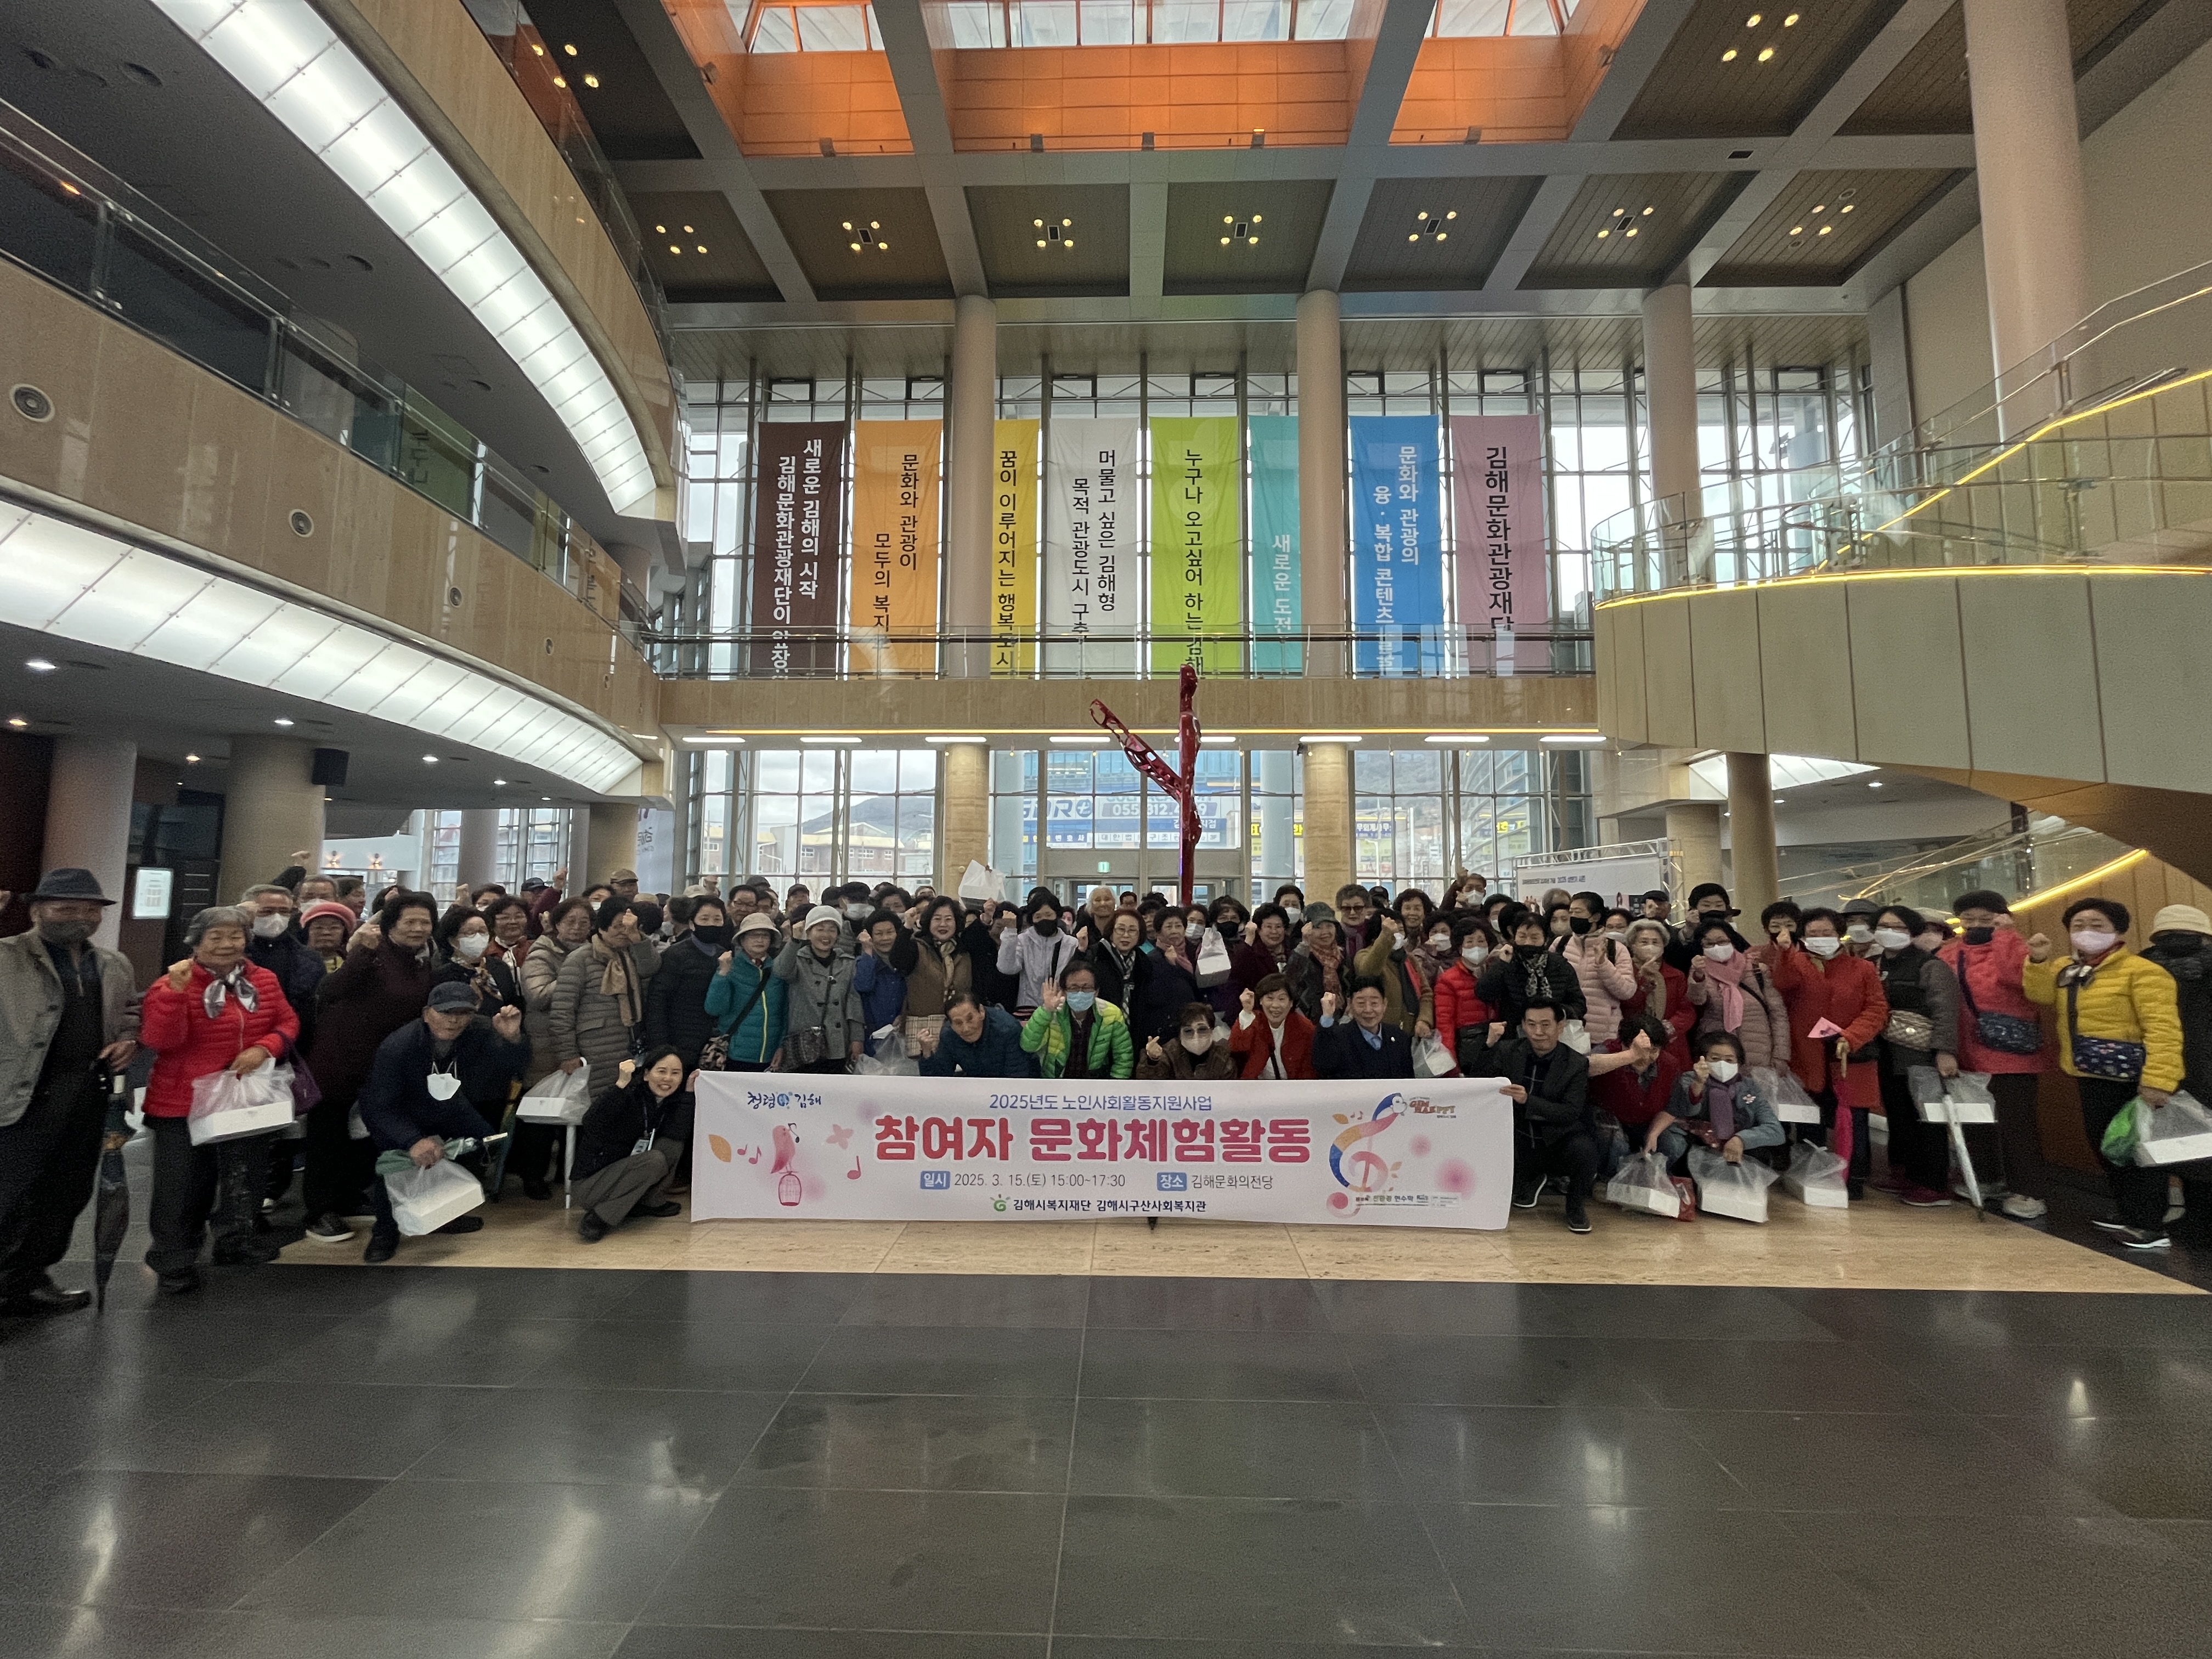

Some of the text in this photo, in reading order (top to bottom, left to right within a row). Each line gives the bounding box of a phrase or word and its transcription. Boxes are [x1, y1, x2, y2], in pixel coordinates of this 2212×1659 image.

[1000, 450, 1017, 487] 꿈이
[1072, 478, 1089, 514] 목적
[1184, 449, 1203, 504] 누구나
[799, 439, 822, 600] 새로운 김해의 시작
[900, 454, 919, 570] 문화와 관광이
[1098, 450, 1115, 612] 머물고 싶은 김해형
[1398, 446, 1419, 566] 문화와 관광의
[773, 455, 797, 624] 김해문화관광재단이
[874, 533, 891, 588] 모두의
[998, 494, 1016, 586] 이루어지는
[1071, 521, 1089, 595] 관광도시
[1184, 593, 1203, 630] 하는
[1272, 534, 1291, 634] 새로운 도전
[1374, 568, 1394, 623] 콘텐츠
[794, 1093, 821, 1109] 김해
[990, 1094, 1211, 1111] 2025년도 노인사회활동지원사업
[876, 1115, 1310, 1163] 참여자 문화체험활동
[924, 1173, 948, 1187] 일시
[955, 1174, 987, 1186] 2025.
[992, 1174, 1003, 1186] 3.
[1008, 1173, 1047, 1188] 15.(토)
[1013, 1199, 1091, 1212] 김해시복지재단
[1097, 1200, 1206, 1212] 김해시구산사회복지관
[1160, 1174, 1273, 1189] 장소 김해문화의전당
